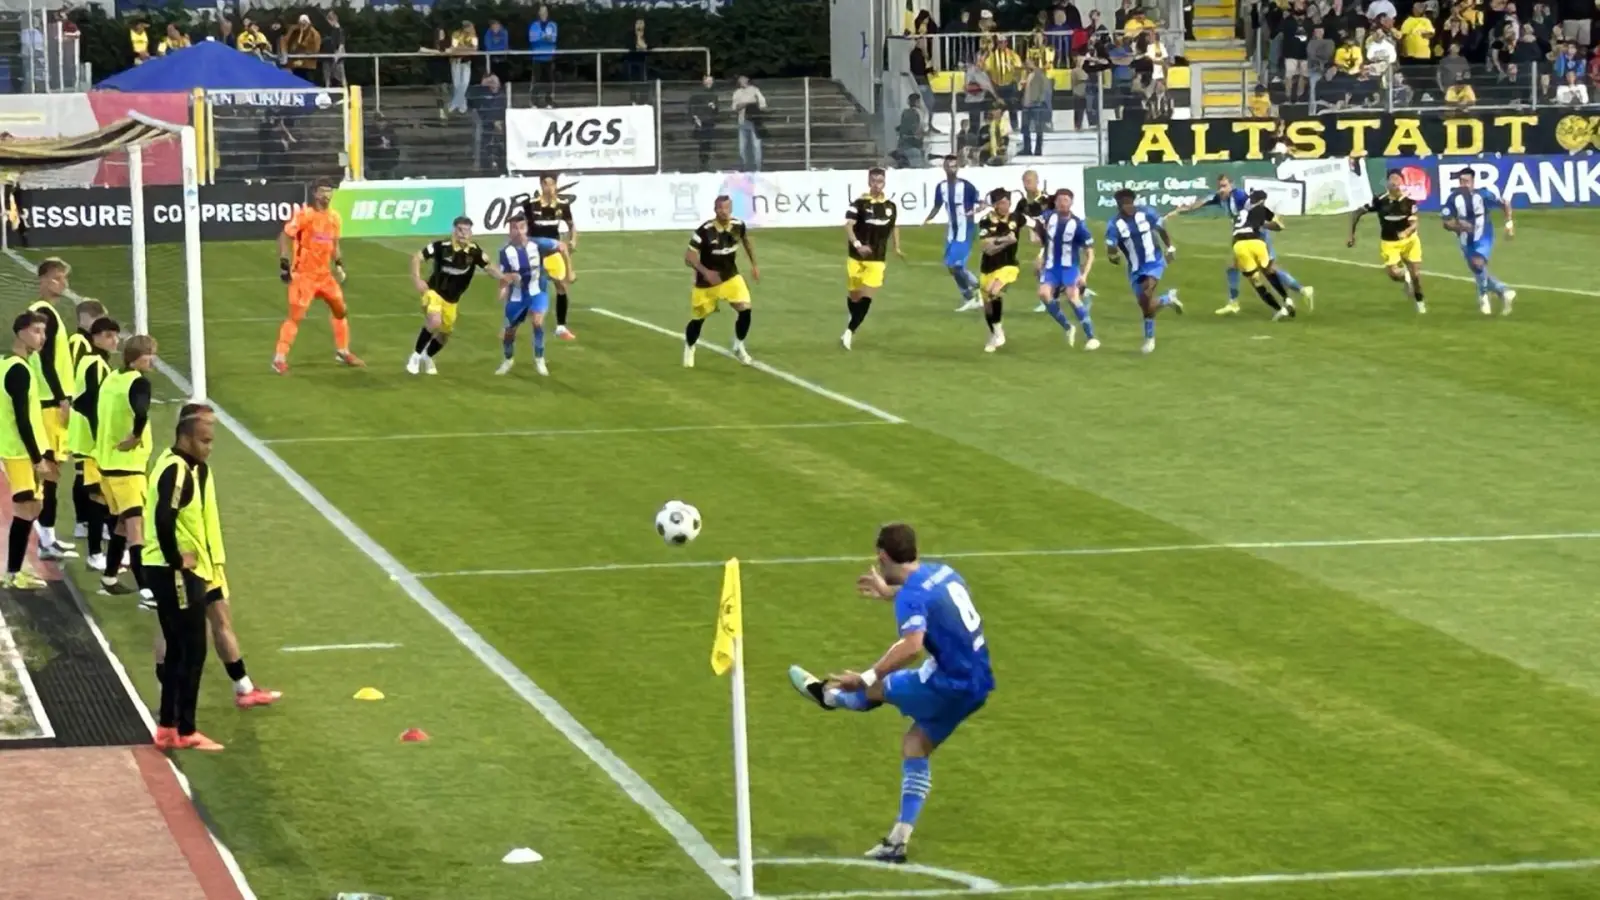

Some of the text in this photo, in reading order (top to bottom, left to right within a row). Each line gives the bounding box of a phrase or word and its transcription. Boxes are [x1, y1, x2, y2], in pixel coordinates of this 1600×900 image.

[541, 118, 622, 147] MGS
[1131, 115, 1538, 166] ALTSTADT
[751, 182, 928, 214] next lel
[1438, 160, 1600, 206] FRANK
[20, 204, 133, 228] RESSURE
[153, 202, 308, 223] COPRESSION
